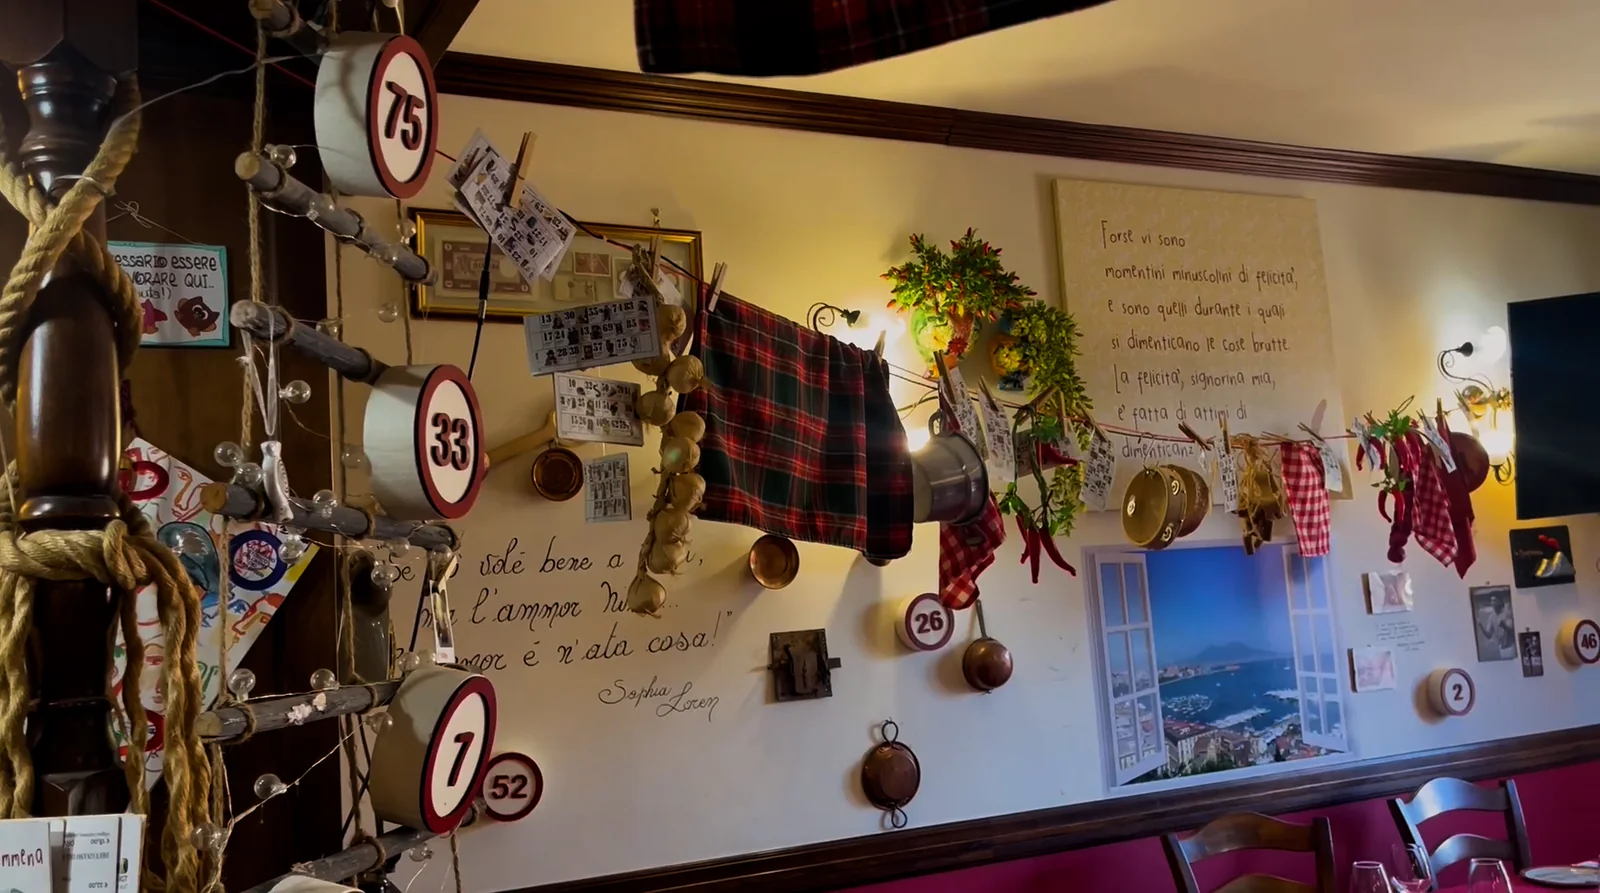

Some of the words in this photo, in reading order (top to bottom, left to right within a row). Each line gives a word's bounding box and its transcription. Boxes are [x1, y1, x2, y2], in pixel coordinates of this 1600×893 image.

[384, 80, 425, 150] 75
[1101, 220, 1133, 249] Forse
[1141, 229, 1152, 244] vi
[1158, 234, 1186, 247] sono
[1105, 264, 1165, 280] momentini
[1172, 266, 1232, 284] minuscolini
[1238, 264, 1249, 284] di
[1108, 300, 1114, 312] e
[1122, 302, 1150, 316] sono
[1157, 300, 1188, 322] quelli
[1194, 296, 1241, 316] durante
[1258, 304, 1285, 324] quali
[1112, 334, 1120, 349] si
[1127, 329, 1200, 352] dimenticano
[1207, 337, 1215, 352] le
[1222, 338, 1245, 352] cose
[1114, 364, 1129, 394] La
[1191, 371, 1245, 391] signorina
[1252, 372, 1275, 391] mia,
[1132, 407, 1168, 430] fatta
[1176, 400, 1187, 420] di
[1194, 404, 1229, 421] attimi
[1236, 401, 1247, 420] di
[430, 412, 471, 471] 33
[1122, 437, 1194, 459] dimenticanz
[539, 535, 593, 572] bene
[606, 554, 625, 568] a
[915, 610, 944, 634] 26
[1581, 633, 1598, 650] 46
[598, 675, 672, 708] Sophia
[656, 681, 719, 723] Loren
[1452, 684, 1464, 701] 2
[491, 774, 528, 800] 52
[1, 848, 44, 867] mmena
